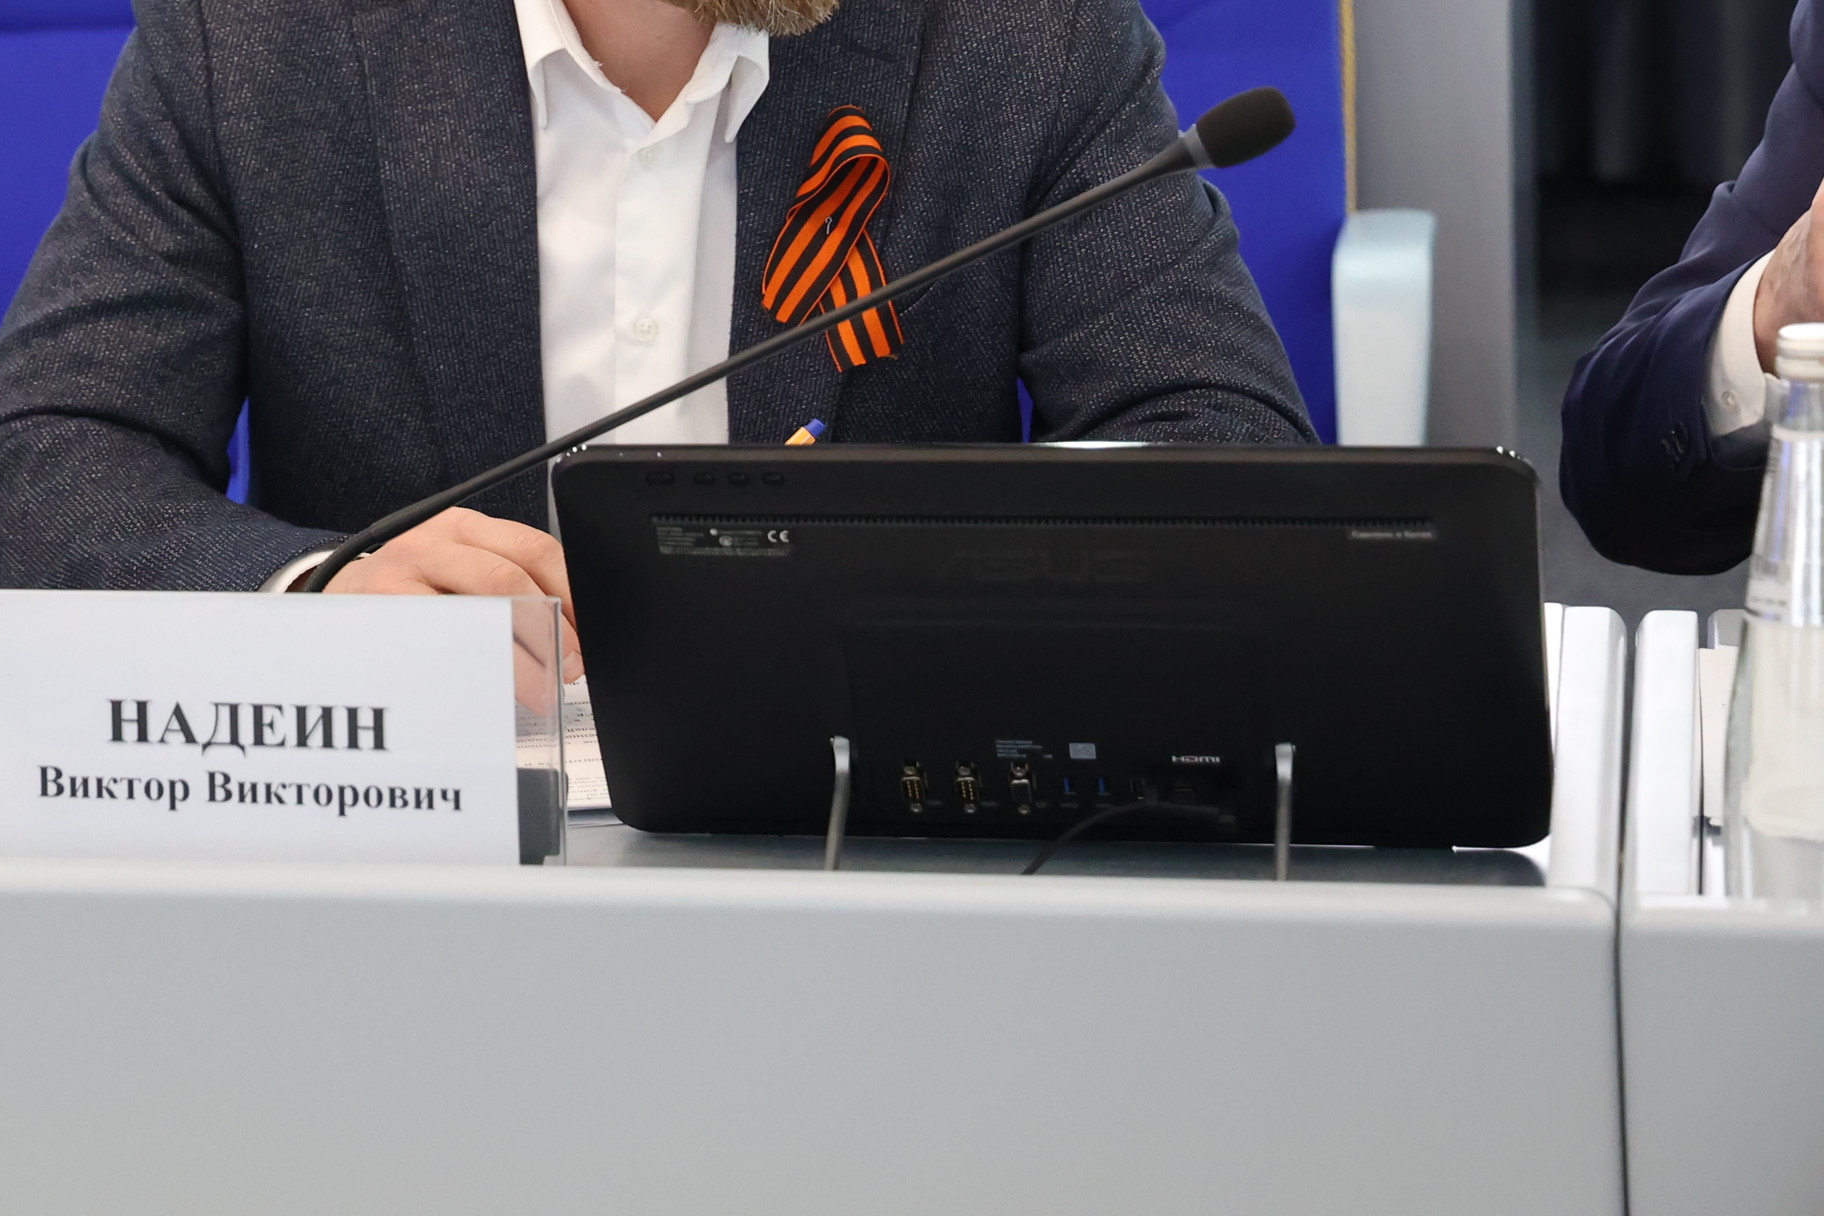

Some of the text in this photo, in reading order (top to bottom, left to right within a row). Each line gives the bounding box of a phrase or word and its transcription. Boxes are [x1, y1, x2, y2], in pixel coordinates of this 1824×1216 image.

[108, 698, 387, 756] НАДЕИН
[38, 765, 462, 817] Виктор Викторович
